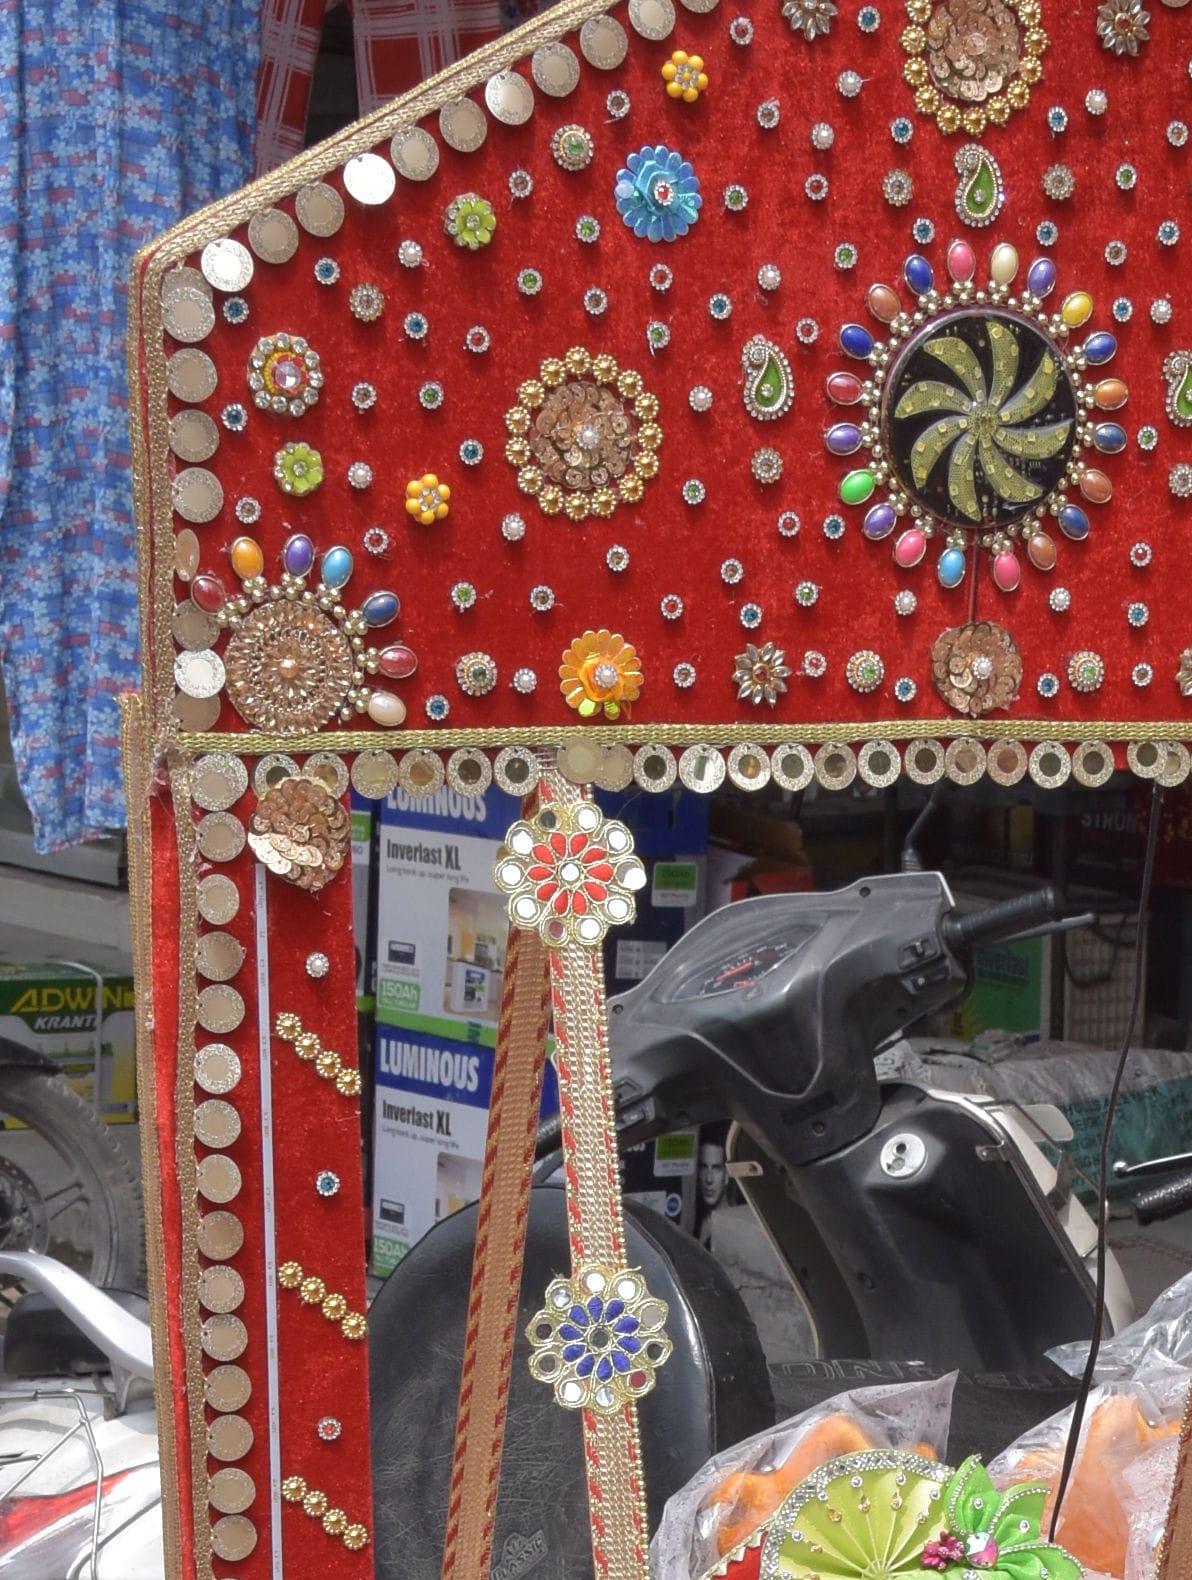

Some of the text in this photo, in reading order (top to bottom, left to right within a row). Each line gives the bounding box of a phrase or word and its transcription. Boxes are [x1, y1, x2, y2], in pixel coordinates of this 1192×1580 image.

[387, 838, 442, 867] Inverlast
[444, 844, 462, 871] XL
[380, 1038, 480, 1093] LUMINOUS
[382, 1099, 452, 1136] Inverlast XL
